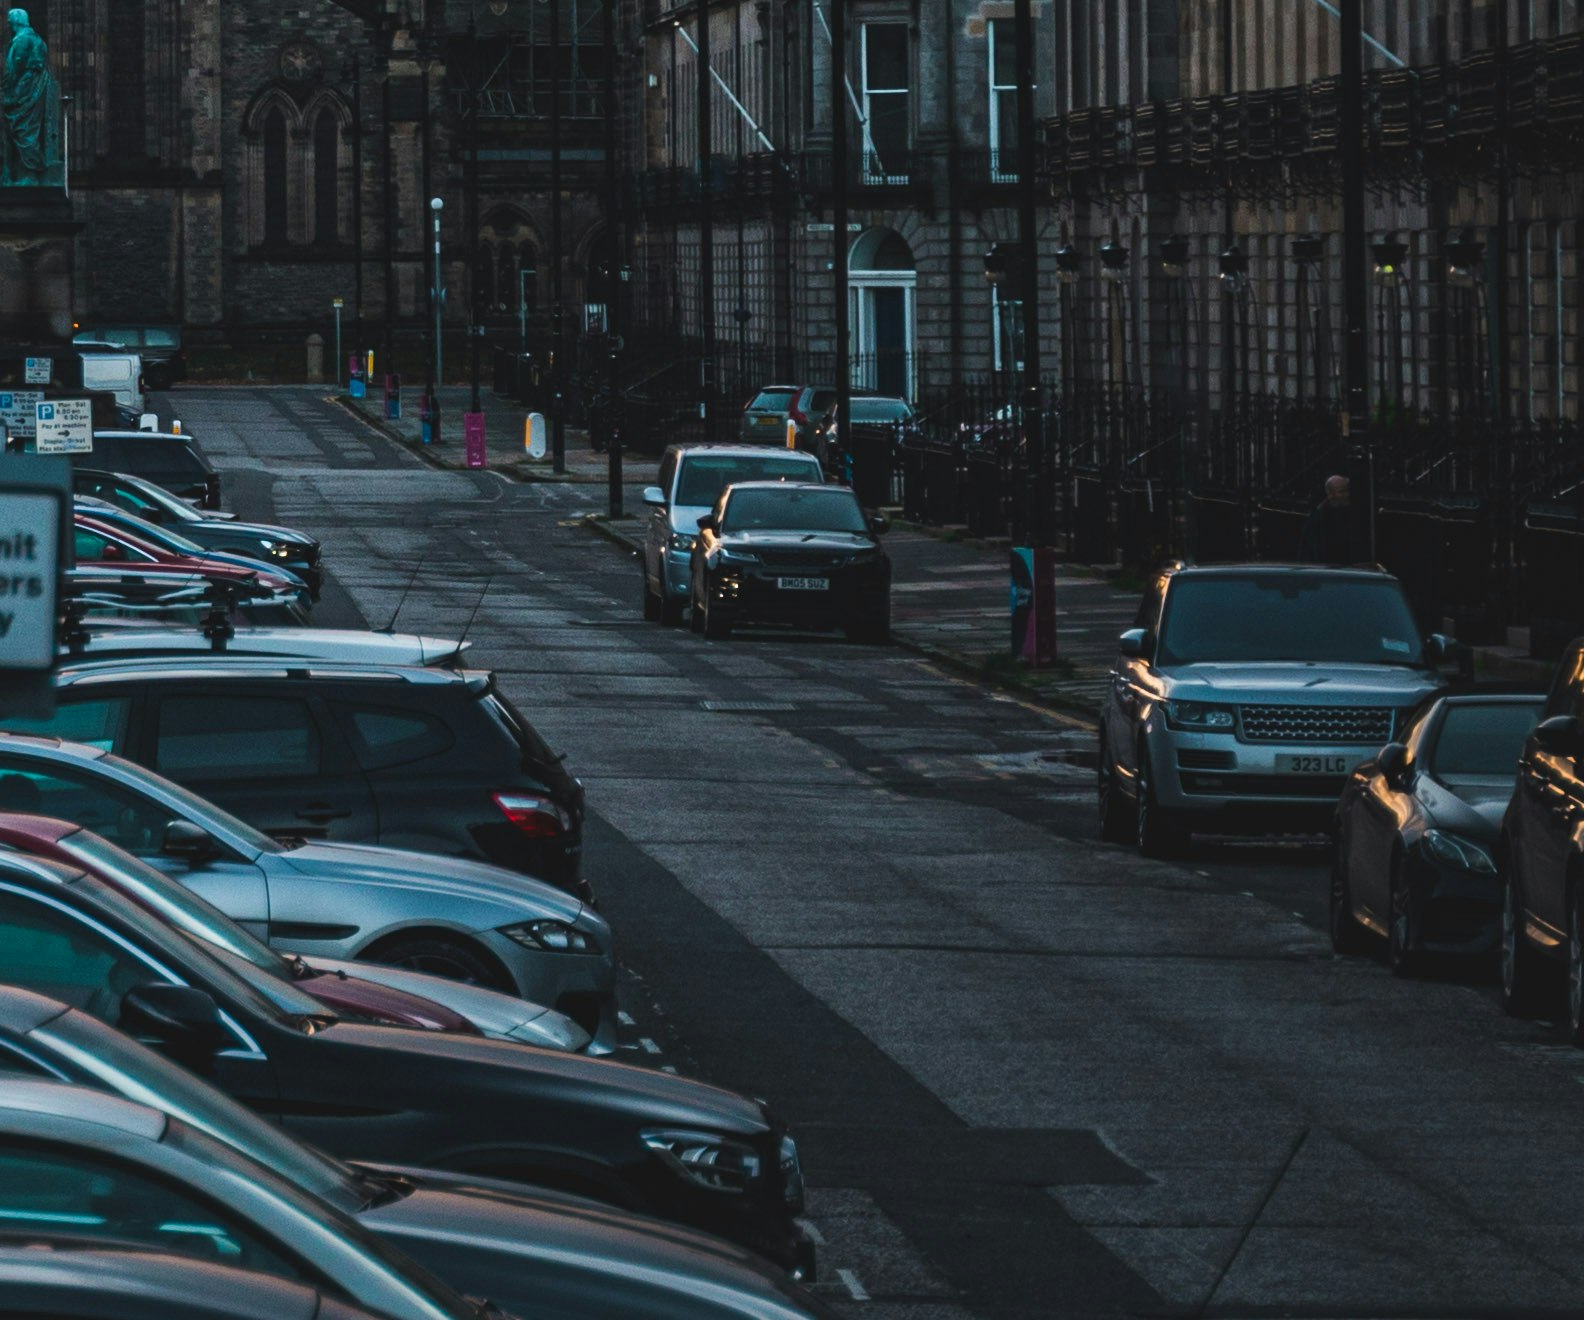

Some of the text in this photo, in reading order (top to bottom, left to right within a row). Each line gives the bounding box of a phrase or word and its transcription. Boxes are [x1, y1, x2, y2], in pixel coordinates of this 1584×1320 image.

[2, 396, 11, 407] P
[41, 405, 52, 419] P
[807, 578, 826, 588] SUZ
[1291, 757, 1346, 772] 323 LG
